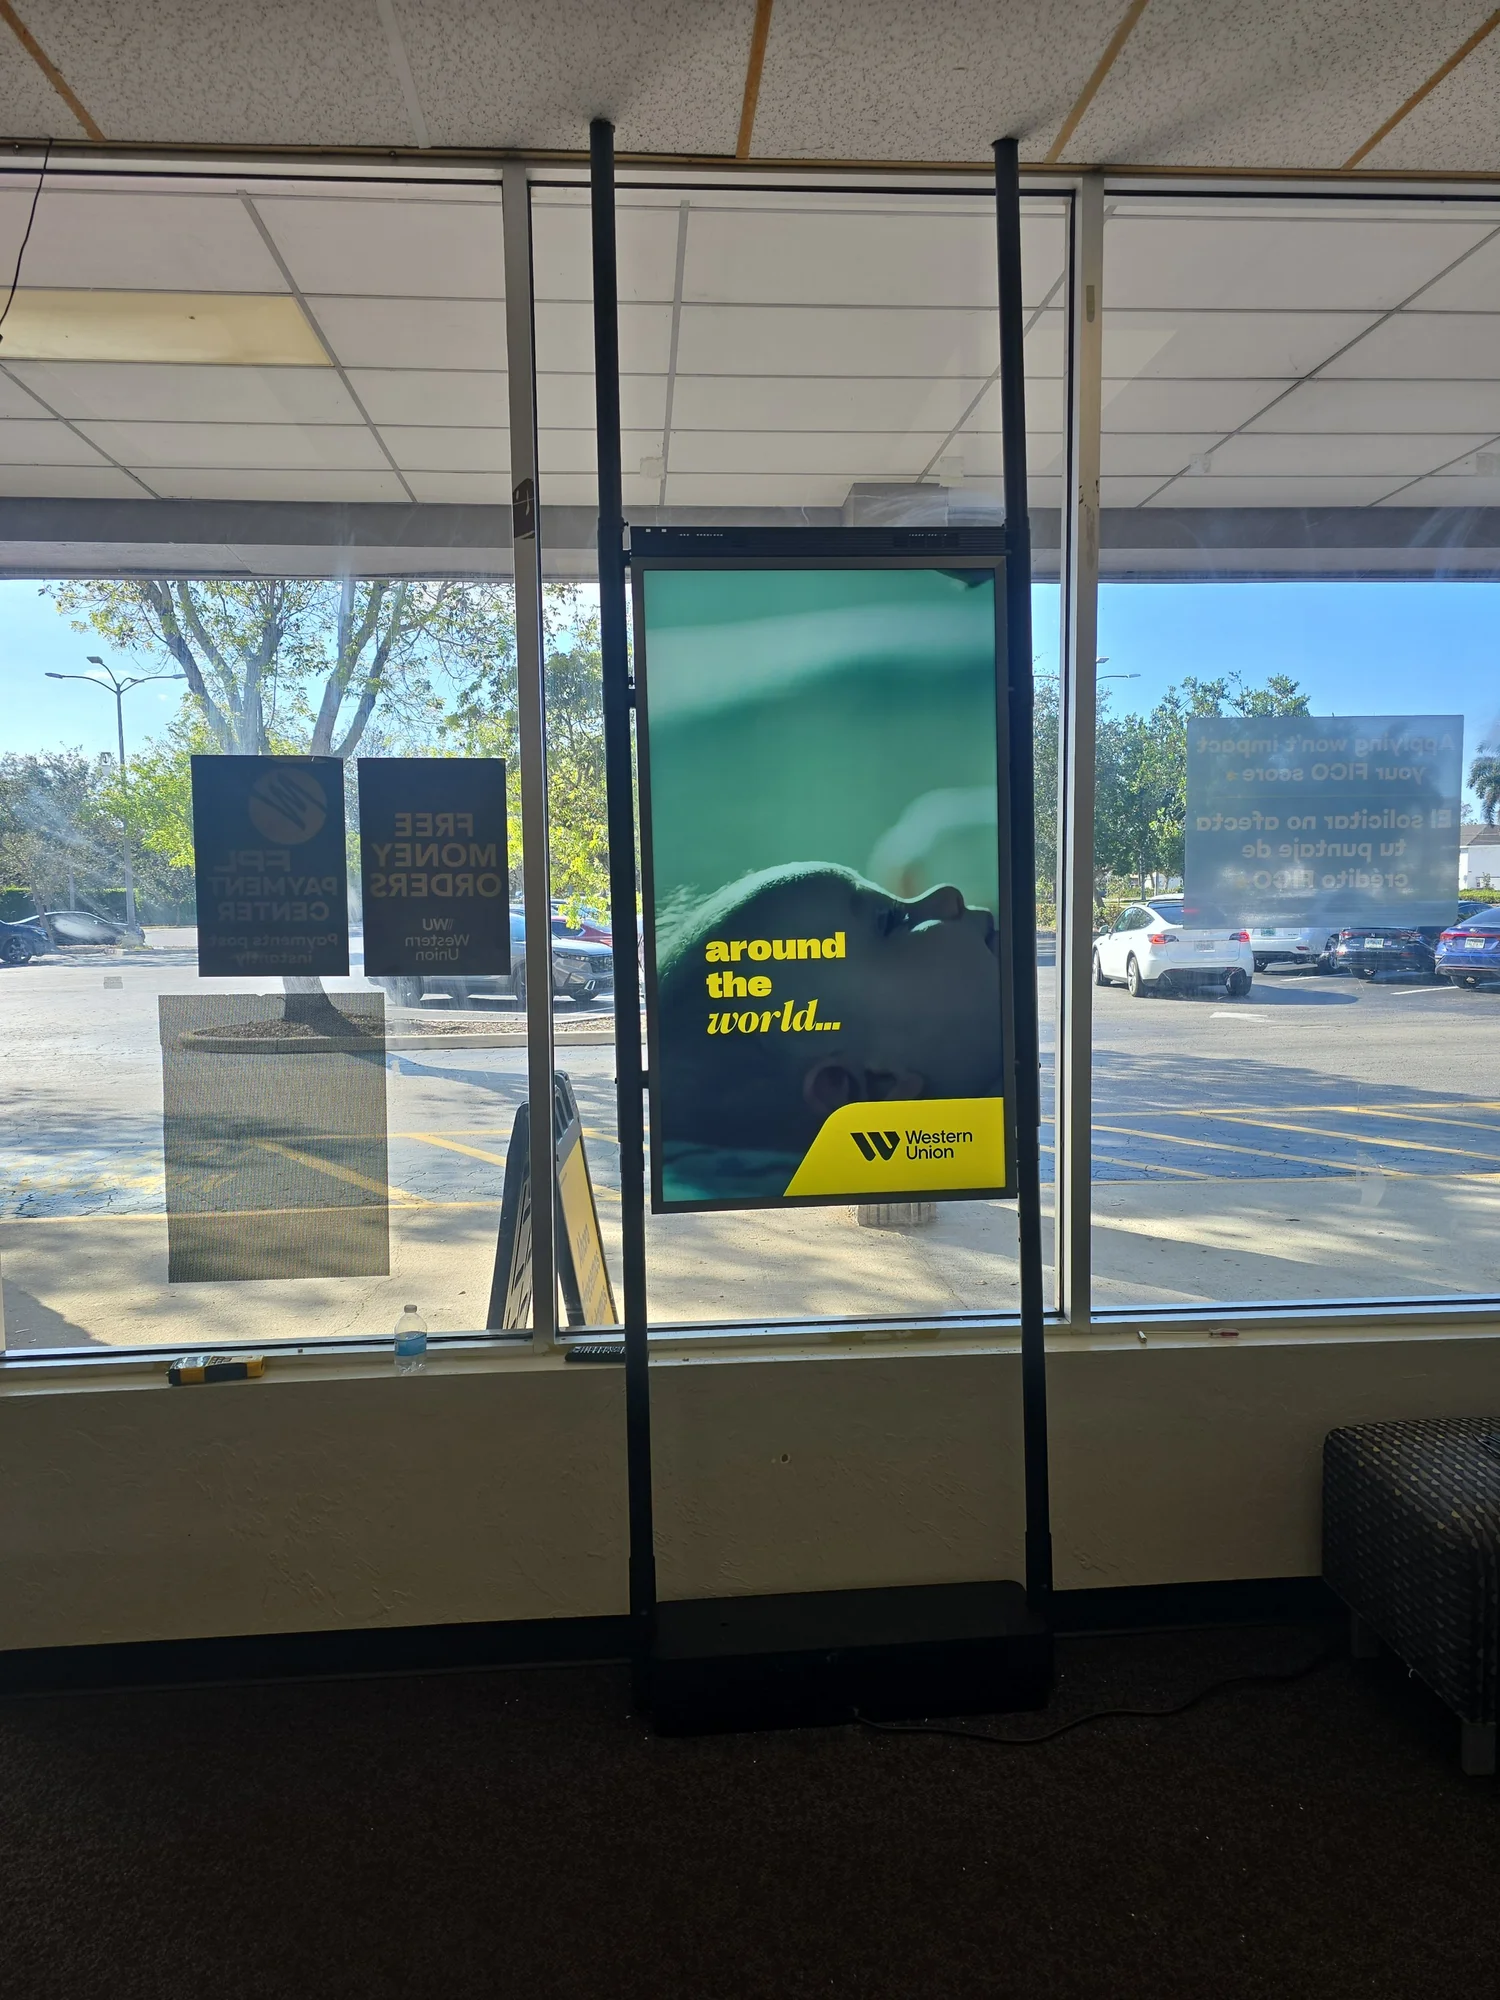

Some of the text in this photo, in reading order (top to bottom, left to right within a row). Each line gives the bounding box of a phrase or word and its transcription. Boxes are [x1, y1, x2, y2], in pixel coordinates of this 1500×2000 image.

[705, 931, 846, 962] around
[705, 970, 772, 998] the
[706, 999, 841, 1035] world...
[905, 1130, 973, 1144] Western
[905, 1145, 954, 1160] Union
